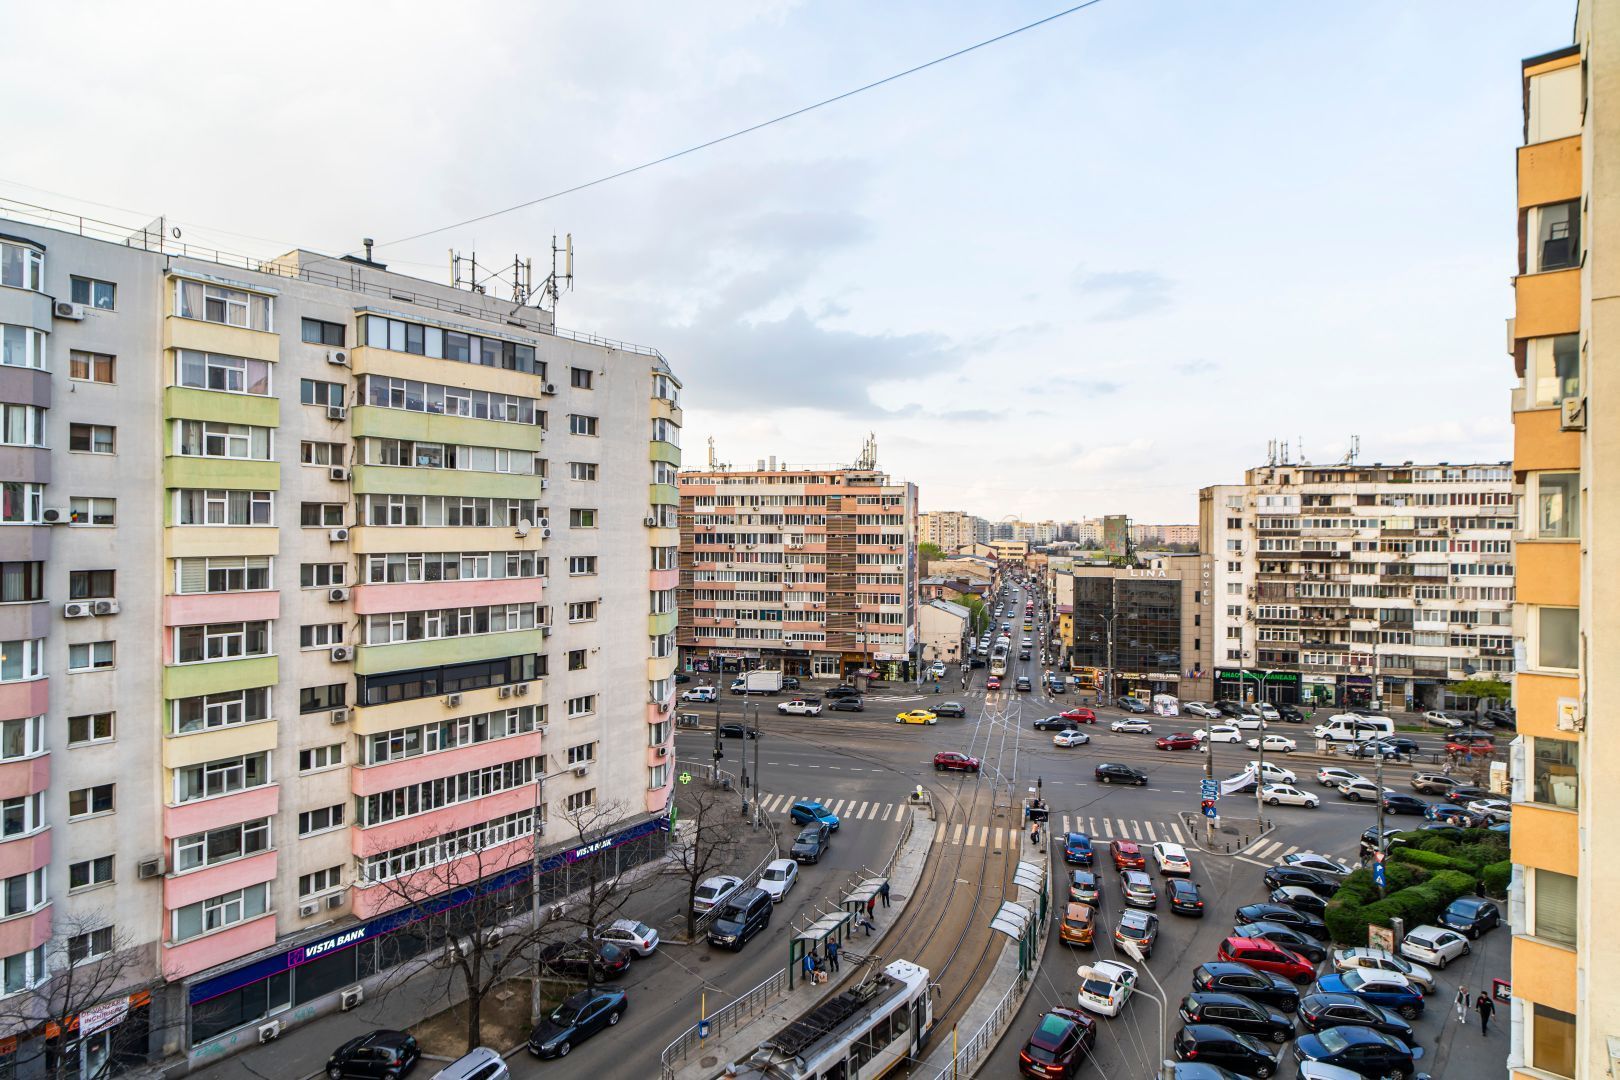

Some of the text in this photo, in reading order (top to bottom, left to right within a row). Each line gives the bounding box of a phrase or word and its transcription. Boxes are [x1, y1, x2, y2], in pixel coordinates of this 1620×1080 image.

[1130, 569, 1166, 577] LINA
[306, 928, 366, 957] VISTA BANK
